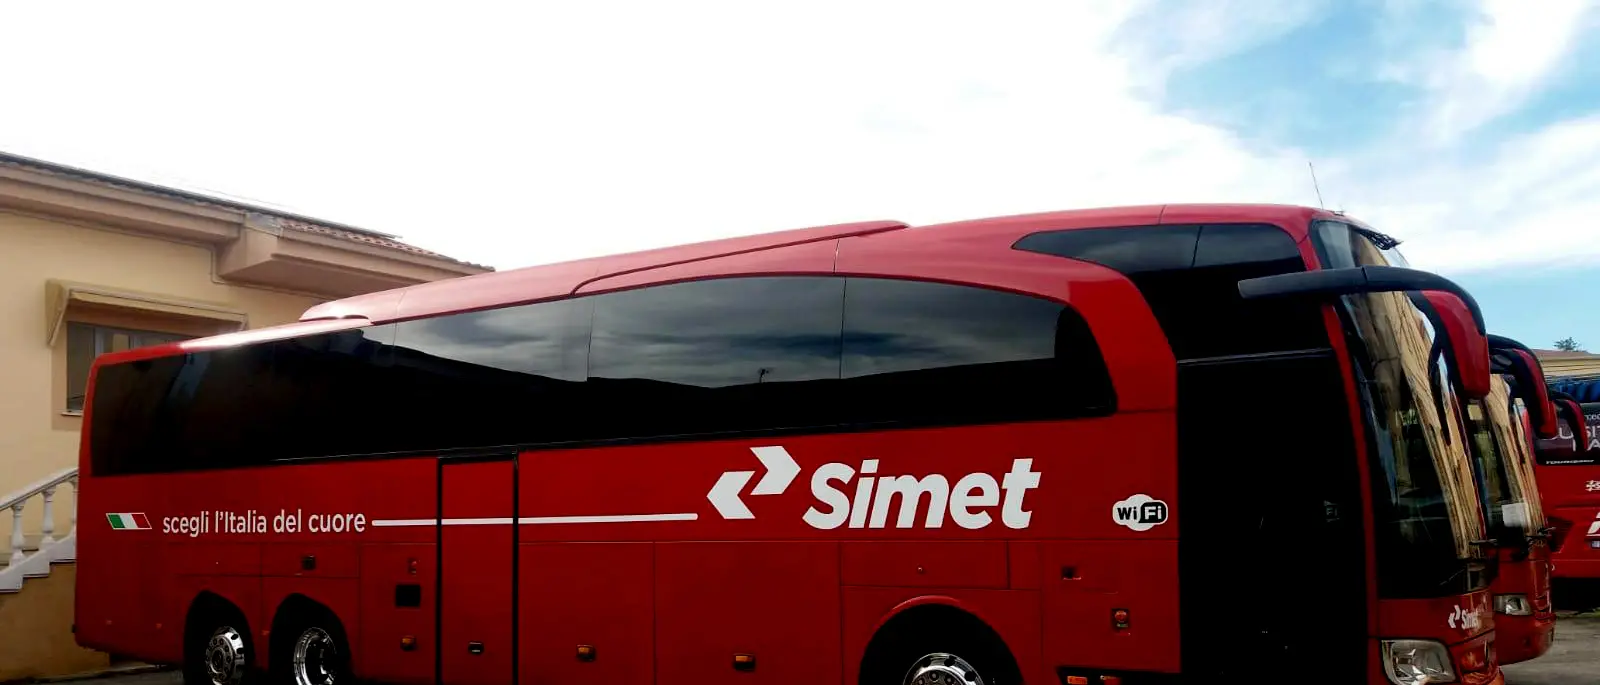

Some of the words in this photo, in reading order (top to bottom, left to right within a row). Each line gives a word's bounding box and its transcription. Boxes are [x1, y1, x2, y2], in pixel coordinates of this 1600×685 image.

[801, 457, 1042, 530] Simet
[162, 510, 210, 538] scegli
[272, 508, 302, 533] del
[307, 512, 367, 533] cuore
